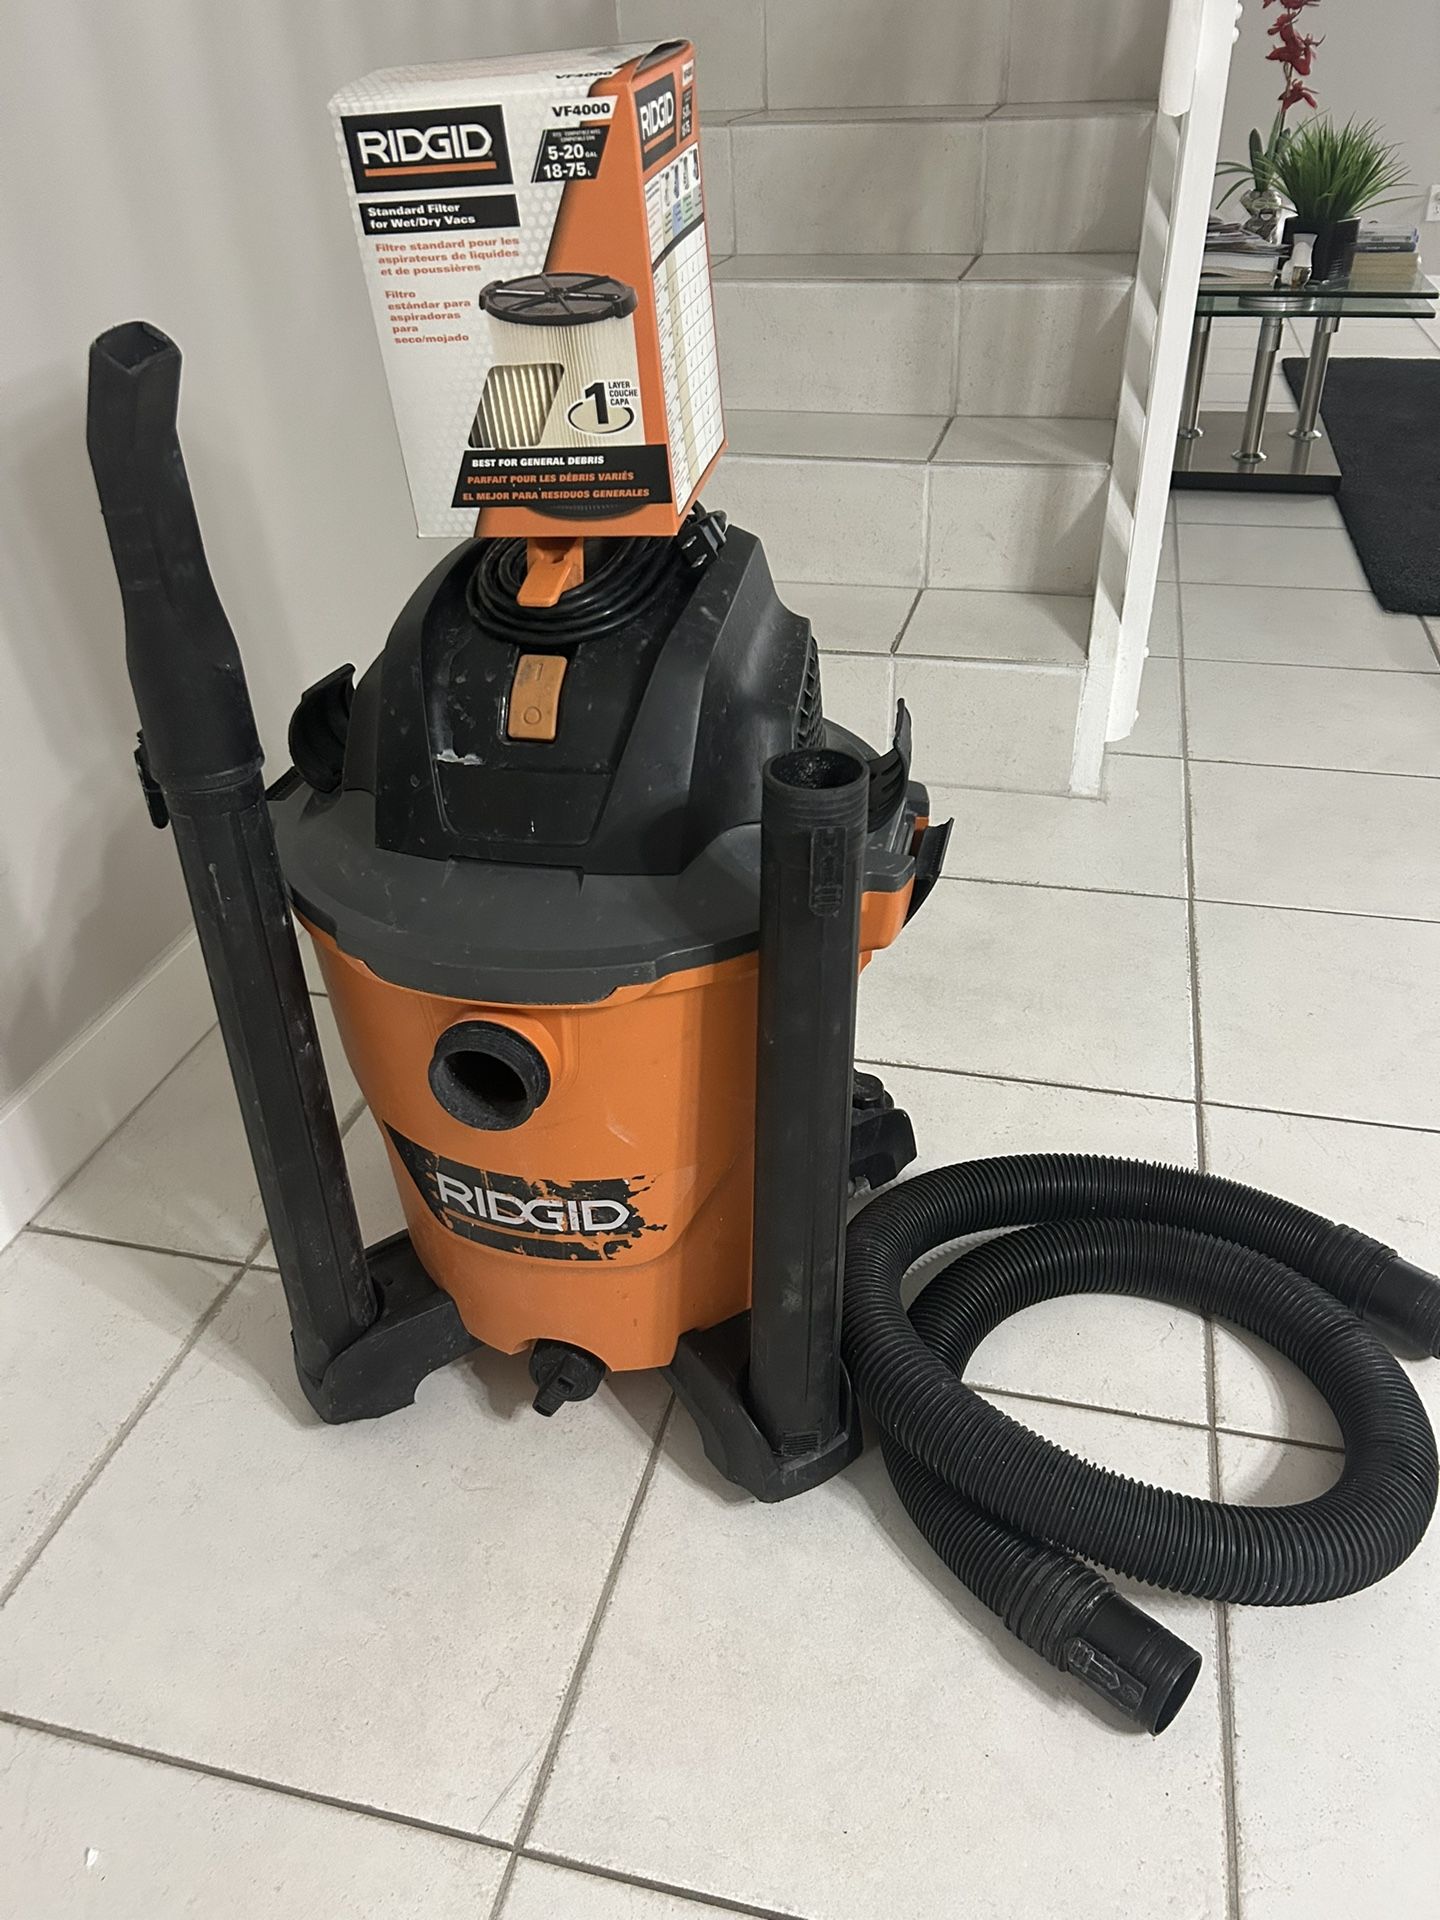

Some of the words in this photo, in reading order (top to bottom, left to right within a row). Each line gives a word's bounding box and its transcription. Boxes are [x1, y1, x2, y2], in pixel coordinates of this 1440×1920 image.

[552, 102, 611, 118] VF4000
[640, 91, 675, 140] RIDGID
[357, 123, 492, 165] RIDGID
[547, 143, 585, 161] 5-20
[543, 161, 587, 179] 18-75
[367, 203, 425, 217] Standard
[427, 203, 461, 214] Filter
[370, 218, 389, 229] for
[390, 216, 441, 228] Wet/Dry
[444, 215, 476, 225] Vacs
[375, 242, 407, 252] Filtre
[410, 239, 465, 251] standard
[468, 238, 498, 249] pour
[501, 236, 520, 246] les
[378, 252, 448, 265] aspirateurs
[451, 251, 467, 261] de
[469, 249, 520, 261] liquides
[380, 267, 393, 276] et
[395, 266, 411, 276] de
[412, 264, 482, 276] poussières
[385, 290, 416, 299] Filtro
[443, 300, 471, 309] para
[390, 312, 461, 322] aspiradoras
[392, 325, 419, 334] para
[394, 333, 470, 344] seco/mojado
[609, 389, 639, 398] COUCHE
[585, 382, 609, 424] 1
[608, 381, 631, 389] LAYER
[610, 398, 630, 406] CAPA
[472, 459, 496, 468] BEST
[498, 458, 518, 467] FOR
[520, 457, 565, 466] GENERAL
[567, 455, 605, 465] DEBRIS
[467, 475, 508, 484] PARFAIT
[510, 474, 537, 483] POUR
[539, 474, 557, 482] LES
[559, 471, 596, 482] DÉBRIS
[598, 470, 635, 480] VARIÉS
[462, 492, 474, 501] EL
[476, 491, 510, 500] MEJOR
[512, 491, 539, 500] PARA
[541, 489, 591, 499] RESIDUOS
[592, 488, 650, 497] GENERALES
[435, 1171, 631, 1232] RIDGID
